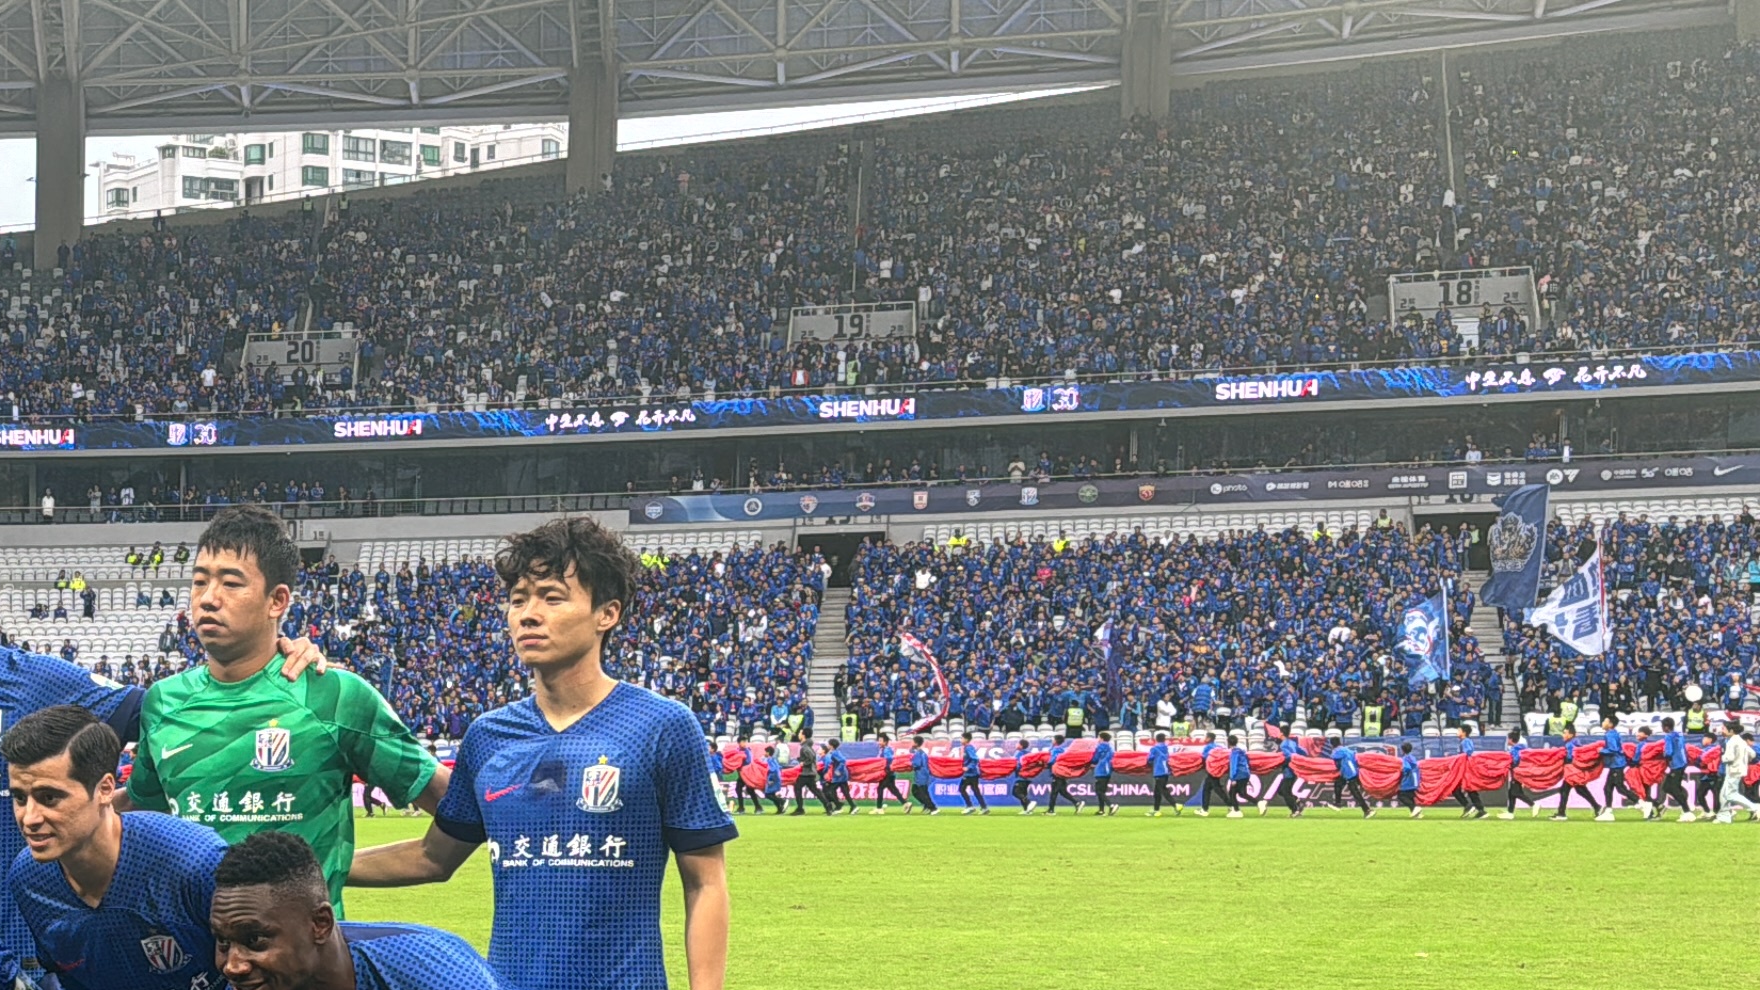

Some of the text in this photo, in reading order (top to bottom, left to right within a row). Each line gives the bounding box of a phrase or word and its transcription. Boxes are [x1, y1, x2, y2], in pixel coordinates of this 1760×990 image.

[1439, 280, 1472, 306] 18
[834, 314, 863, 338] 19
[287, 340, 313, 363] 20
[1215, 378, 1318, 400] SHENHUA
[820, 398, 915, 418] SHENHUA
[334, 420, 422, 438] SHENHUA
[186, 790, 297, 813] 交通銀行
[204, 814, 217, 822] OF
[220, 813, 304, 823] COMMUNICATIONS
[512, 833, 627, 859] 交通銀行
[502, 858, 635, 868] BANK OF COMMUNICATIONS
